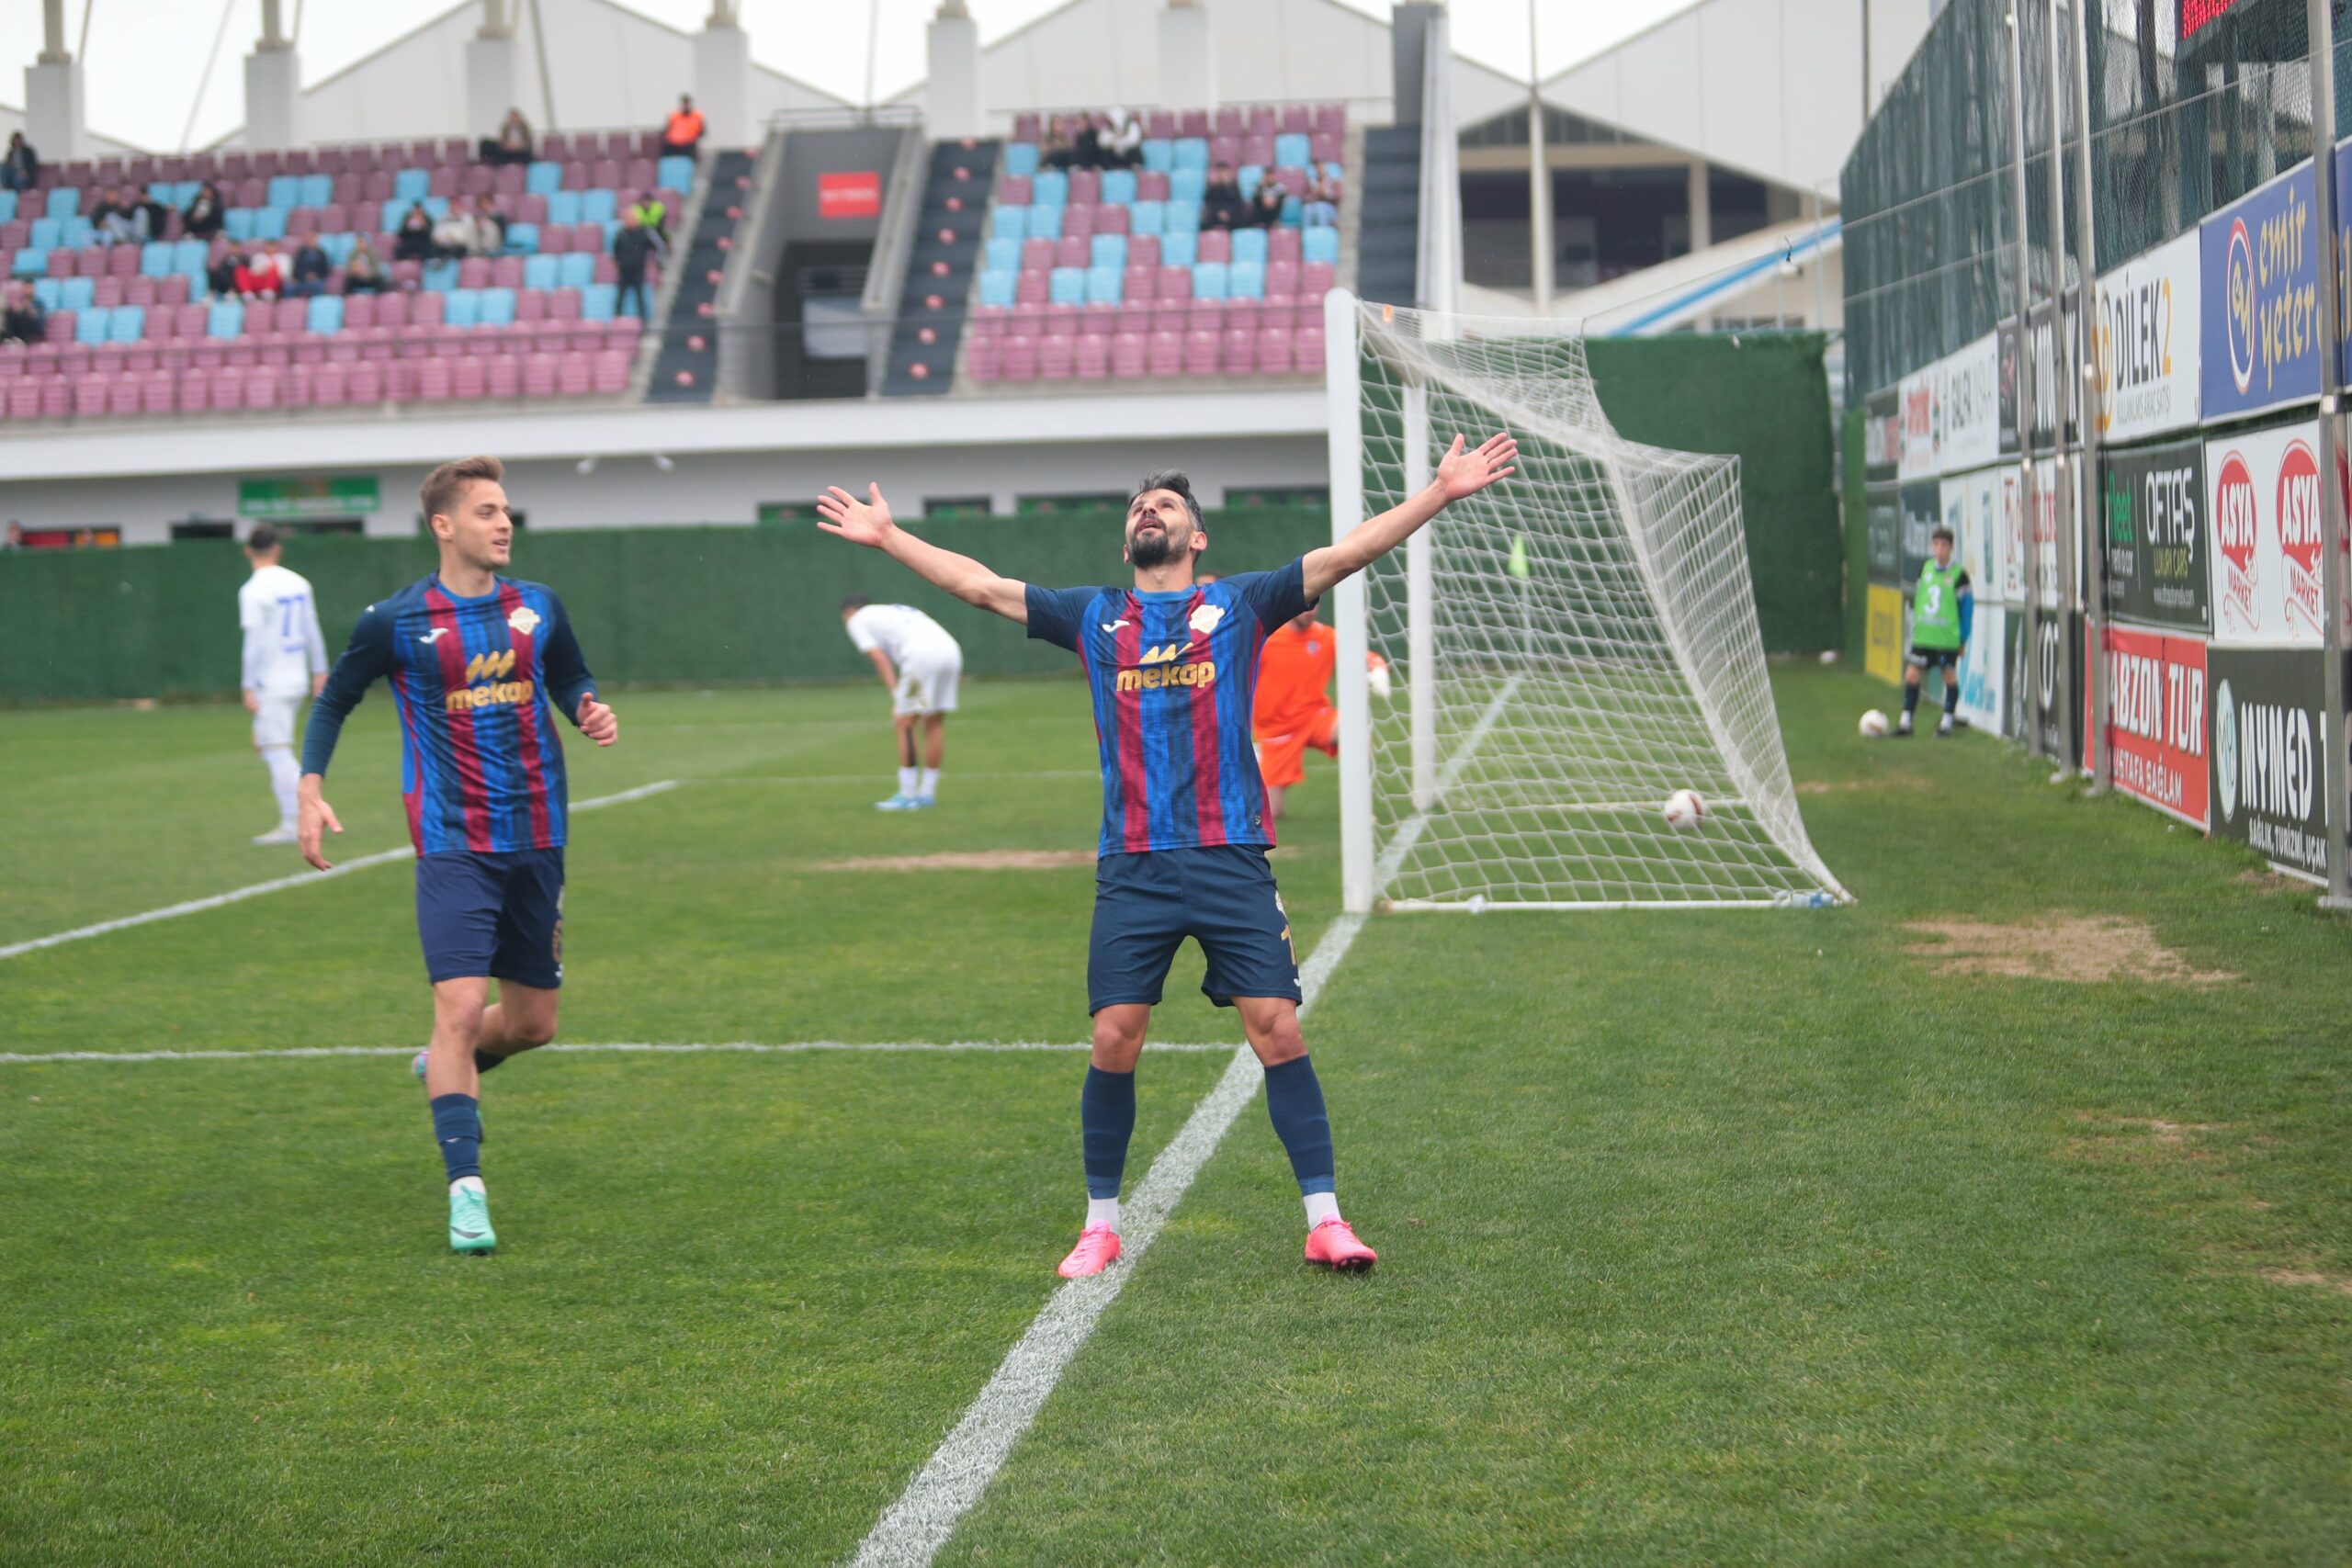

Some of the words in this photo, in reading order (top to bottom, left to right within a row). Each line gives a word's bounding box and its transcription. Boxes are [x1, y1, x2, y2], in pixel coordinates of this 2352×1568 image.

[2259, 184, 2306, 289] emir
[2221, 482, 2254, 548] ASYA
[2282, 474, 2322, 547] ASYA
[1925, 584, 1940, 615] 3
[2228, 565, 2252, 615] MARKET
[2290, 564, 2319, 618] MARKET
[446, 679, 534, 709] mekap
[1116, 661, 1216, 691] mekap
[2108, 650, 2164, 743] ABZON
[2168, 662, 2203, 757] TUR
[2113, 747, 2144, 790] USTAFA
[2146, 752, 2182, 807] SAĞLAM
[2241, 701, 2312, 822] MYMED
[2306, 834, 2326, 874] UÇAK
